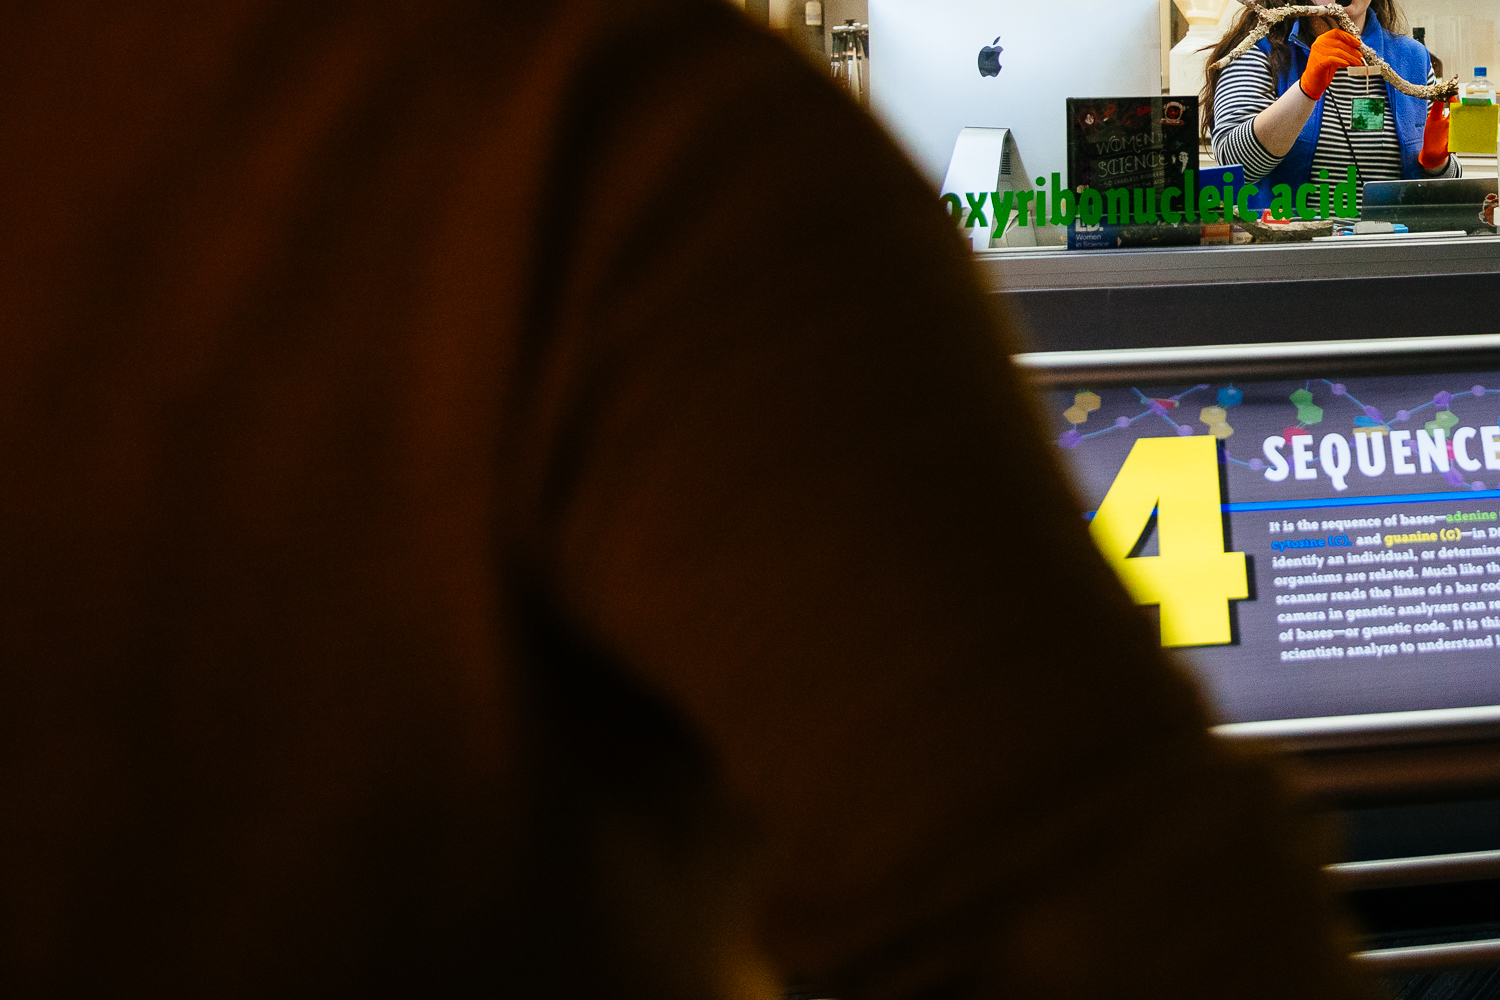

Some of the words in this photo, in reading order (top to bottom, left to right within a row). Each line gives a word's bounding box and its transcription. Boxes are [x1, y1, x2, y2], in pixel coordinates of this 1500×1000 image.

[1096, 132, 1155, 155] WOMEN
[1098, 149, 1168, 178] SCIENCE
[941, 168, 1259, 238] oxyribonucleic
[1270, 166, 1359, 220] acid
[1269, 521, 1280, 532] It
[1283, 521, 1294, 531] is
[1297, 519, 1319, 531] the
[1321, 518, 1381, 531] sequence
[1383, 514, 1397, 526] of
[1089, 435, 1248, 647] 4
[1271, 537, 1325, 551] cytosine
[1328, 534, 1352, 546] (C),
[1356, 533, 1381, 545] and
[1384, 531, 1438, 547] guanine
[1272, 554, 1324, 569] identify
[1327, 555, 1344, 565] an
[1347, 549, 1419, 564] individual,
[1421, 550, 1435, 560] or
[1274, 573, 1342, 589] organisms
[1345, 572, 1366, 582] are
[1369, 567, 1419, 580] related.
[1422, 564, 1457, 577] Much
[1459, 563, 1484, 575] like
[1276, 593, 1328, 605] scanner
[1331, 588, 1367, 600] reads
[1369, 587, 1392, 599] the
[1393, 585, 1426, 597] lines
[1427, 583, 1442, 595] of
[1444, 585, 1453, 594] a
[1455, 582, 1478, 594] bar
[1277, 611, 1326, 623] camera
[1328, 608, 1343, 620] in
[1346, 605, 1395, 622] genetic
[1398, 602, 1459, 618] analyzers
[1462, 601, 1486, 612] can
[1279, 629, 1293, 642] of
[1362, 622, 1411, 640] genetic
[1414, 620, 1449, 634] code.
[1452, 619, 1464, 631] It
[1466, 618, 1478, 630] is
[1280, 646, 1344, 661] scientists
[1346, 643, 1398, 658] analyze
[1400, 642, 1415, 653] to
[1417, 635, 1494, 652] understand
